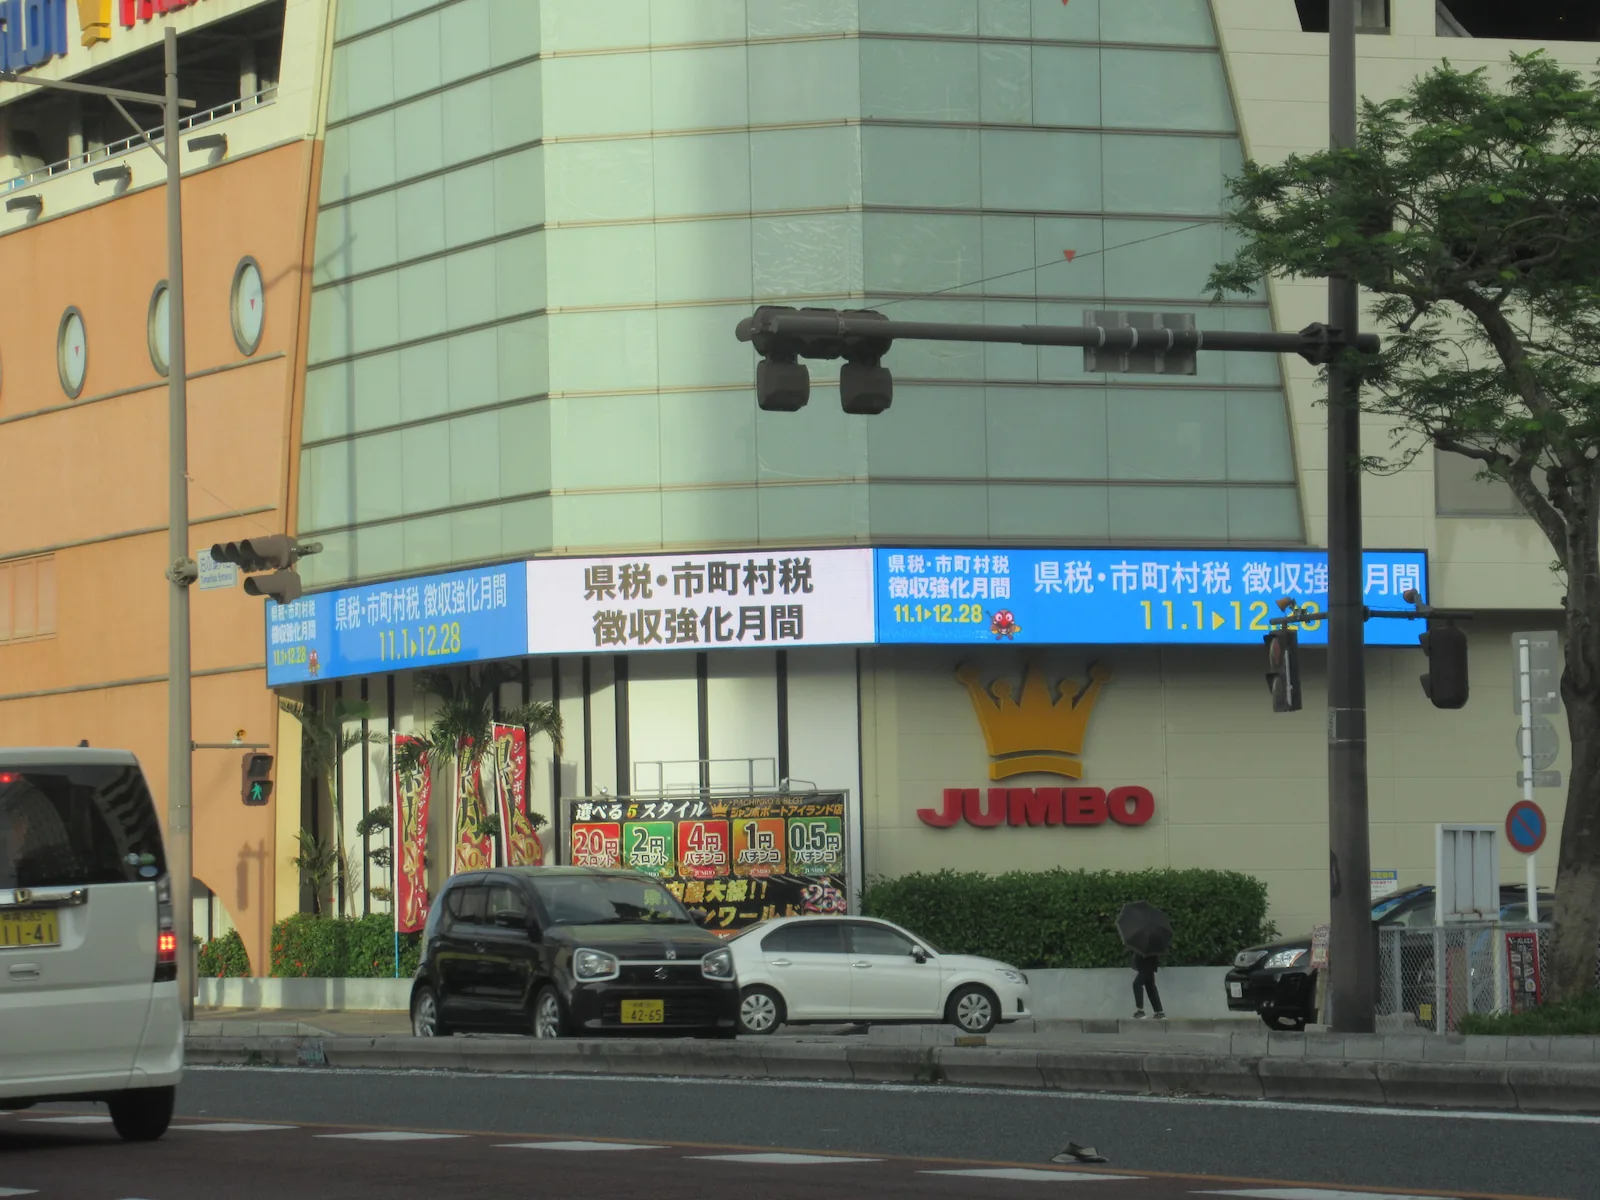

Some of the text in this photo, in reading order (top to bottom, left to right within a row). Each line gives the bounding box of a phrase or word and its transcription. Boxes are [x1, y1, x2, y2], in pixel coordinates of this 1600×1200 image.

[584, 557, 814, 601] 県税・市町村税
[888, 554, 1010, 574] 県税・市町村税
[1033, 560, 1420, 595] 県税・市町村税 徴収強月間
[335, 573, 508, 631] 県税・市町村税 徴収強化月間
[888, 577, 1011, 600] 徴収強化月間
[592, 604, 804, 646] 徴収強化月間
[894, 603, 983, 623] 11.1 12.28
[1140, 600, 1204, 631] 11.1
[379, 622, 461, 661] 11.1 12.28
[917, 786, 1155, 828] JUMBO
[574, 828, 619, 855] 20円
[632, 826, 665, 854] 2円
[688, 822, 721, 851] 4円
[744, 821, 775, 851] 1円
[789, 821, 842, 851] 0.5円
[578, 854, 616, 867] スロット
[630, 851, 668, 867] スロット
